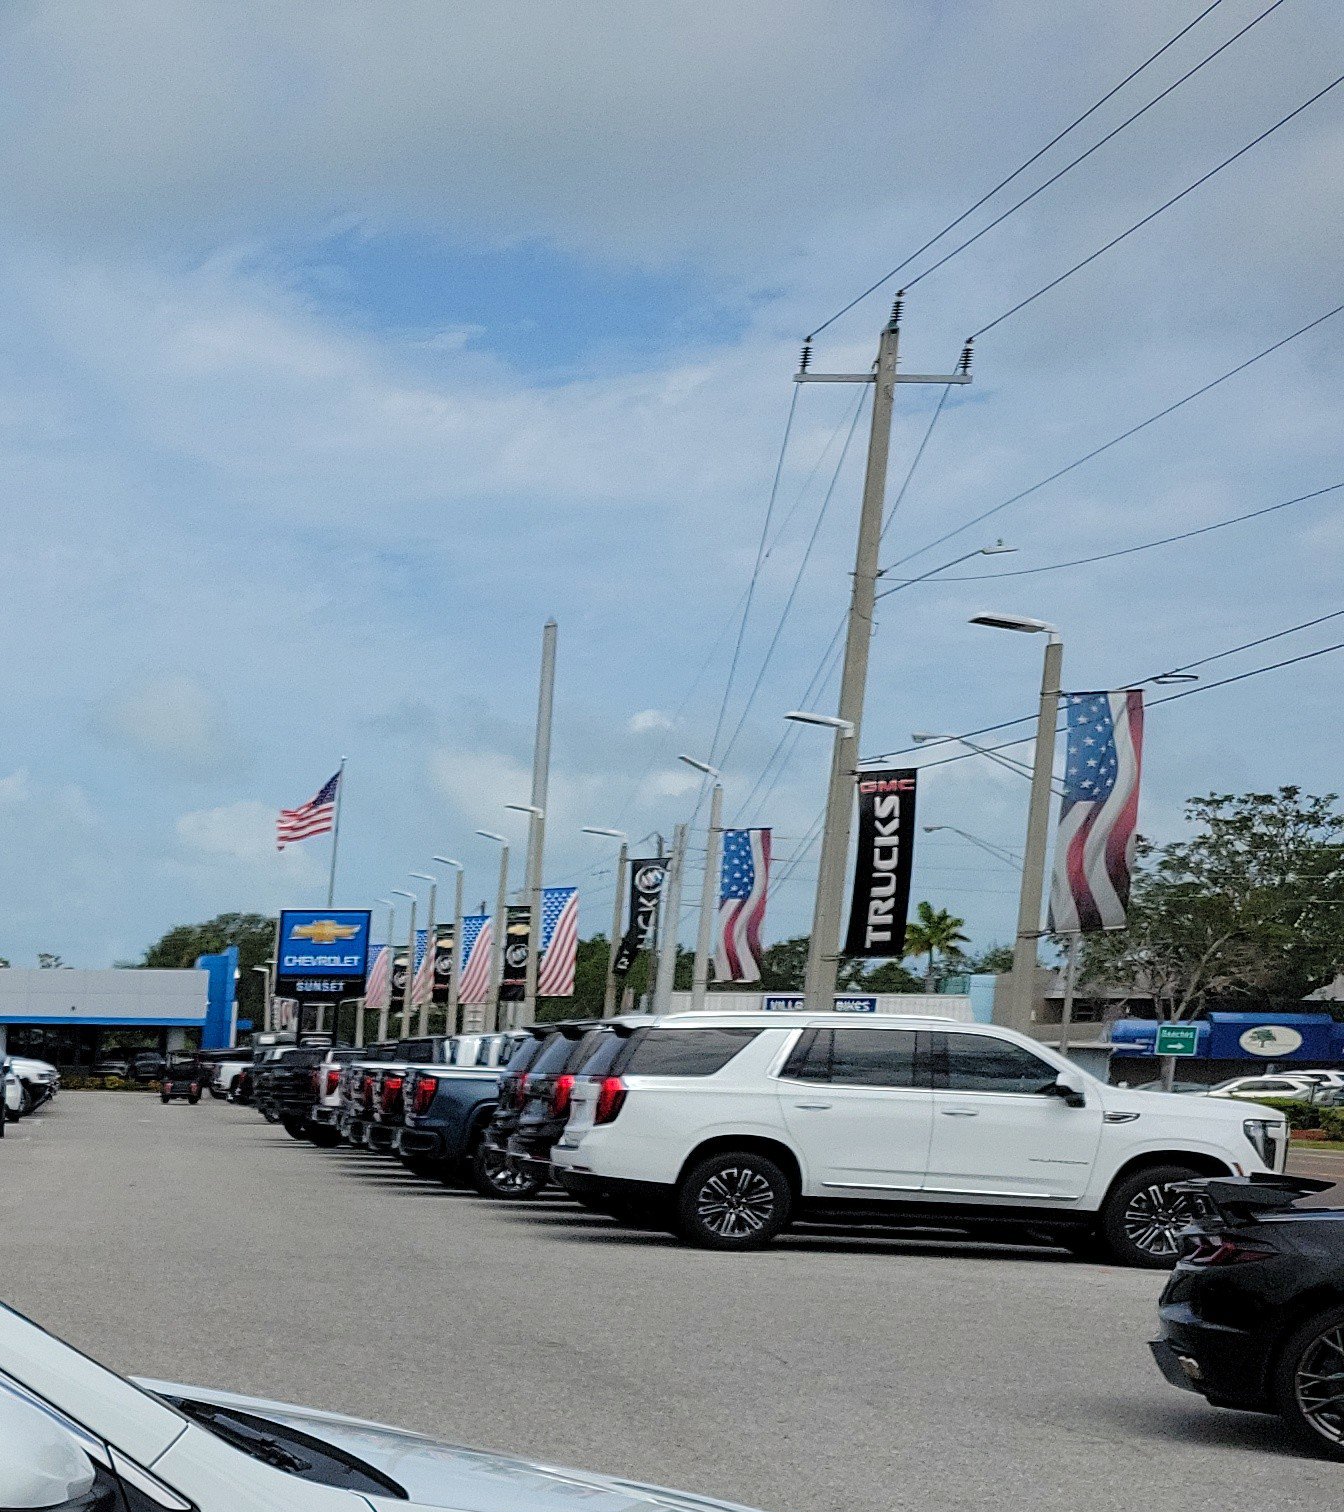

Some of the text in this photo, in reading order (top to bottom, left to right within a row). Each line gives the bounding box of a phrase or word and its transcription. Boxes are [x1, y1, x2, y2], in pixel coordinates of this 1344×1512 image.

[859, 778, 916, 793] GMC
[864, 794, 901, 949] TRUCKS
[283, 955, 362, 967] CHEVROLET
[295, 981, 346, 992] SUNSET
